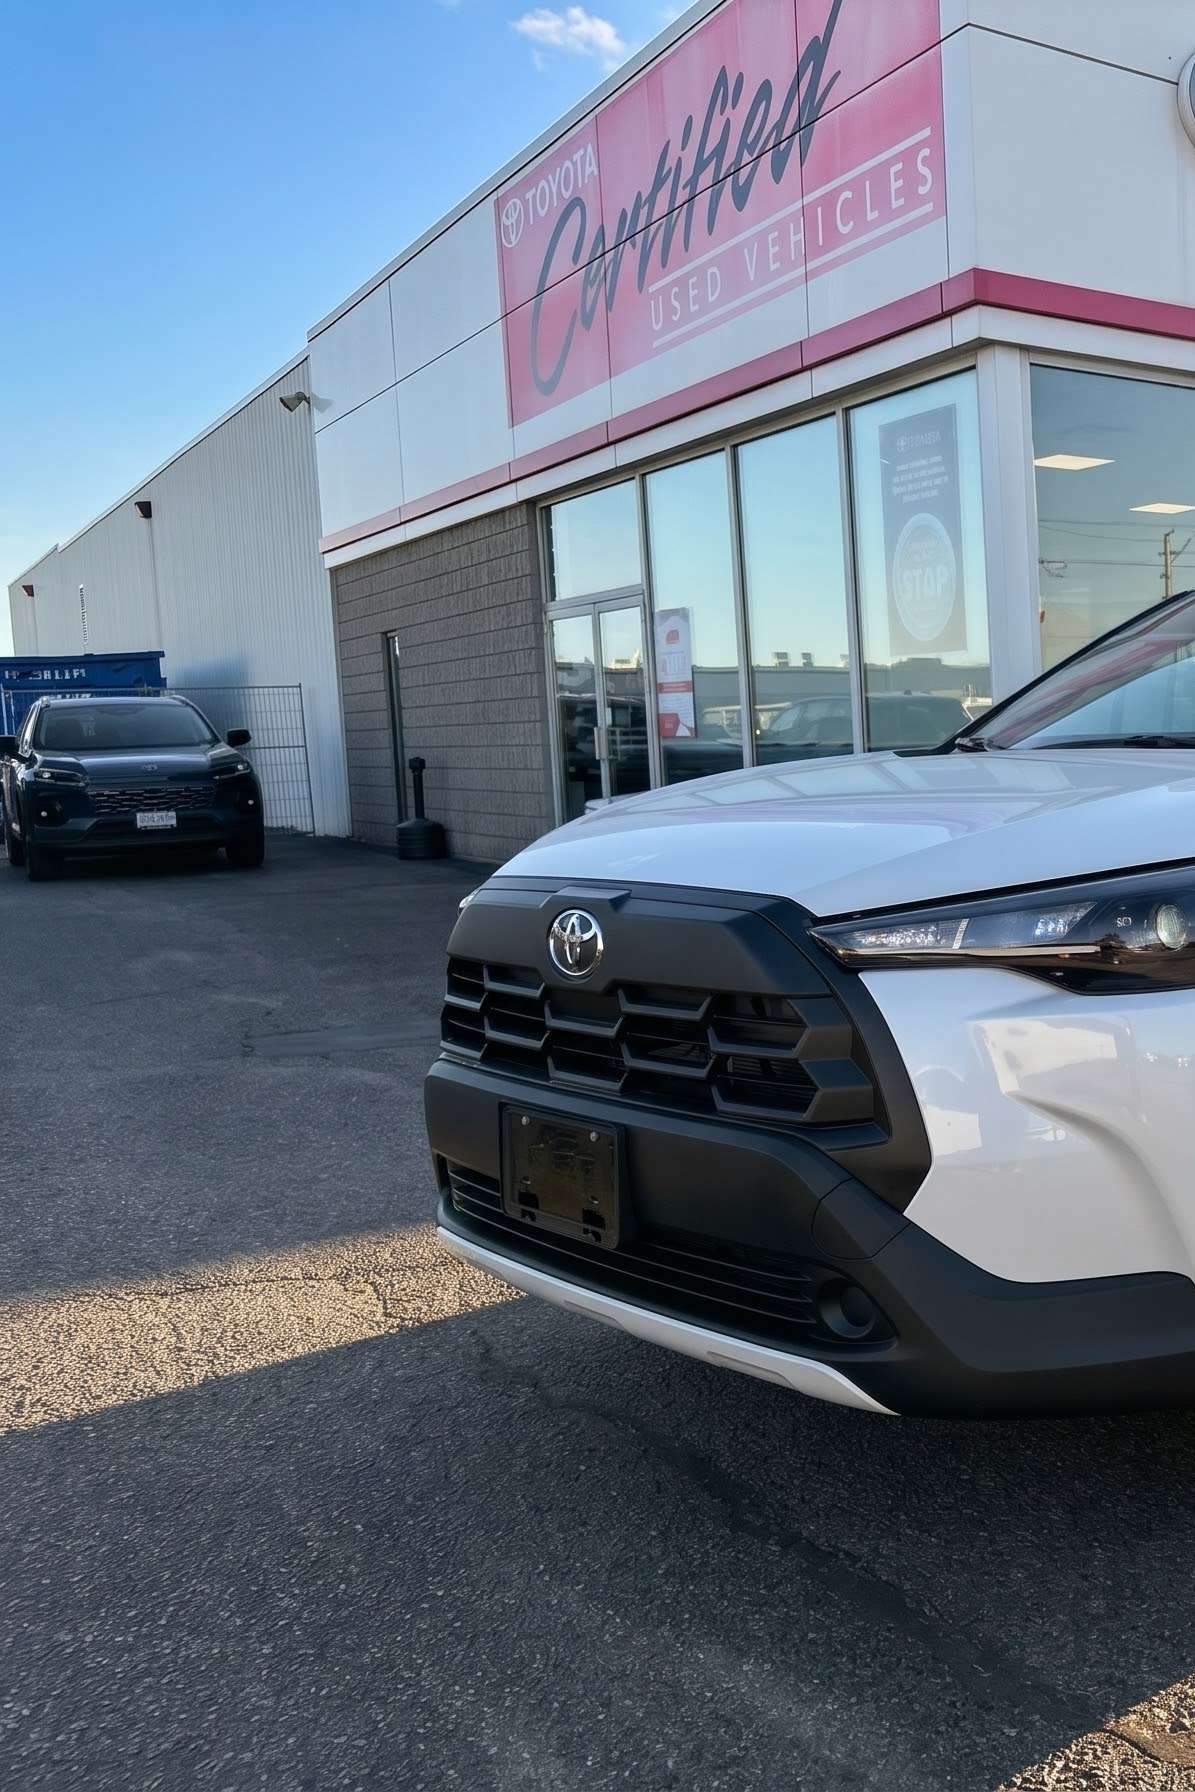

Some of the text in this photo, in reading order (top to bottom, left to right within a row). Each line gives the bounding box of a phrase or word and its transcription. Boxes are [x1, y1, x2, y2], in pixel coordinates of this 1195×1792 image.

[525, 142, 599, 226] TOYOTA
[530, 0, 843, 397] Certified
[650, 147, 934, 331] USED VEHICLES
